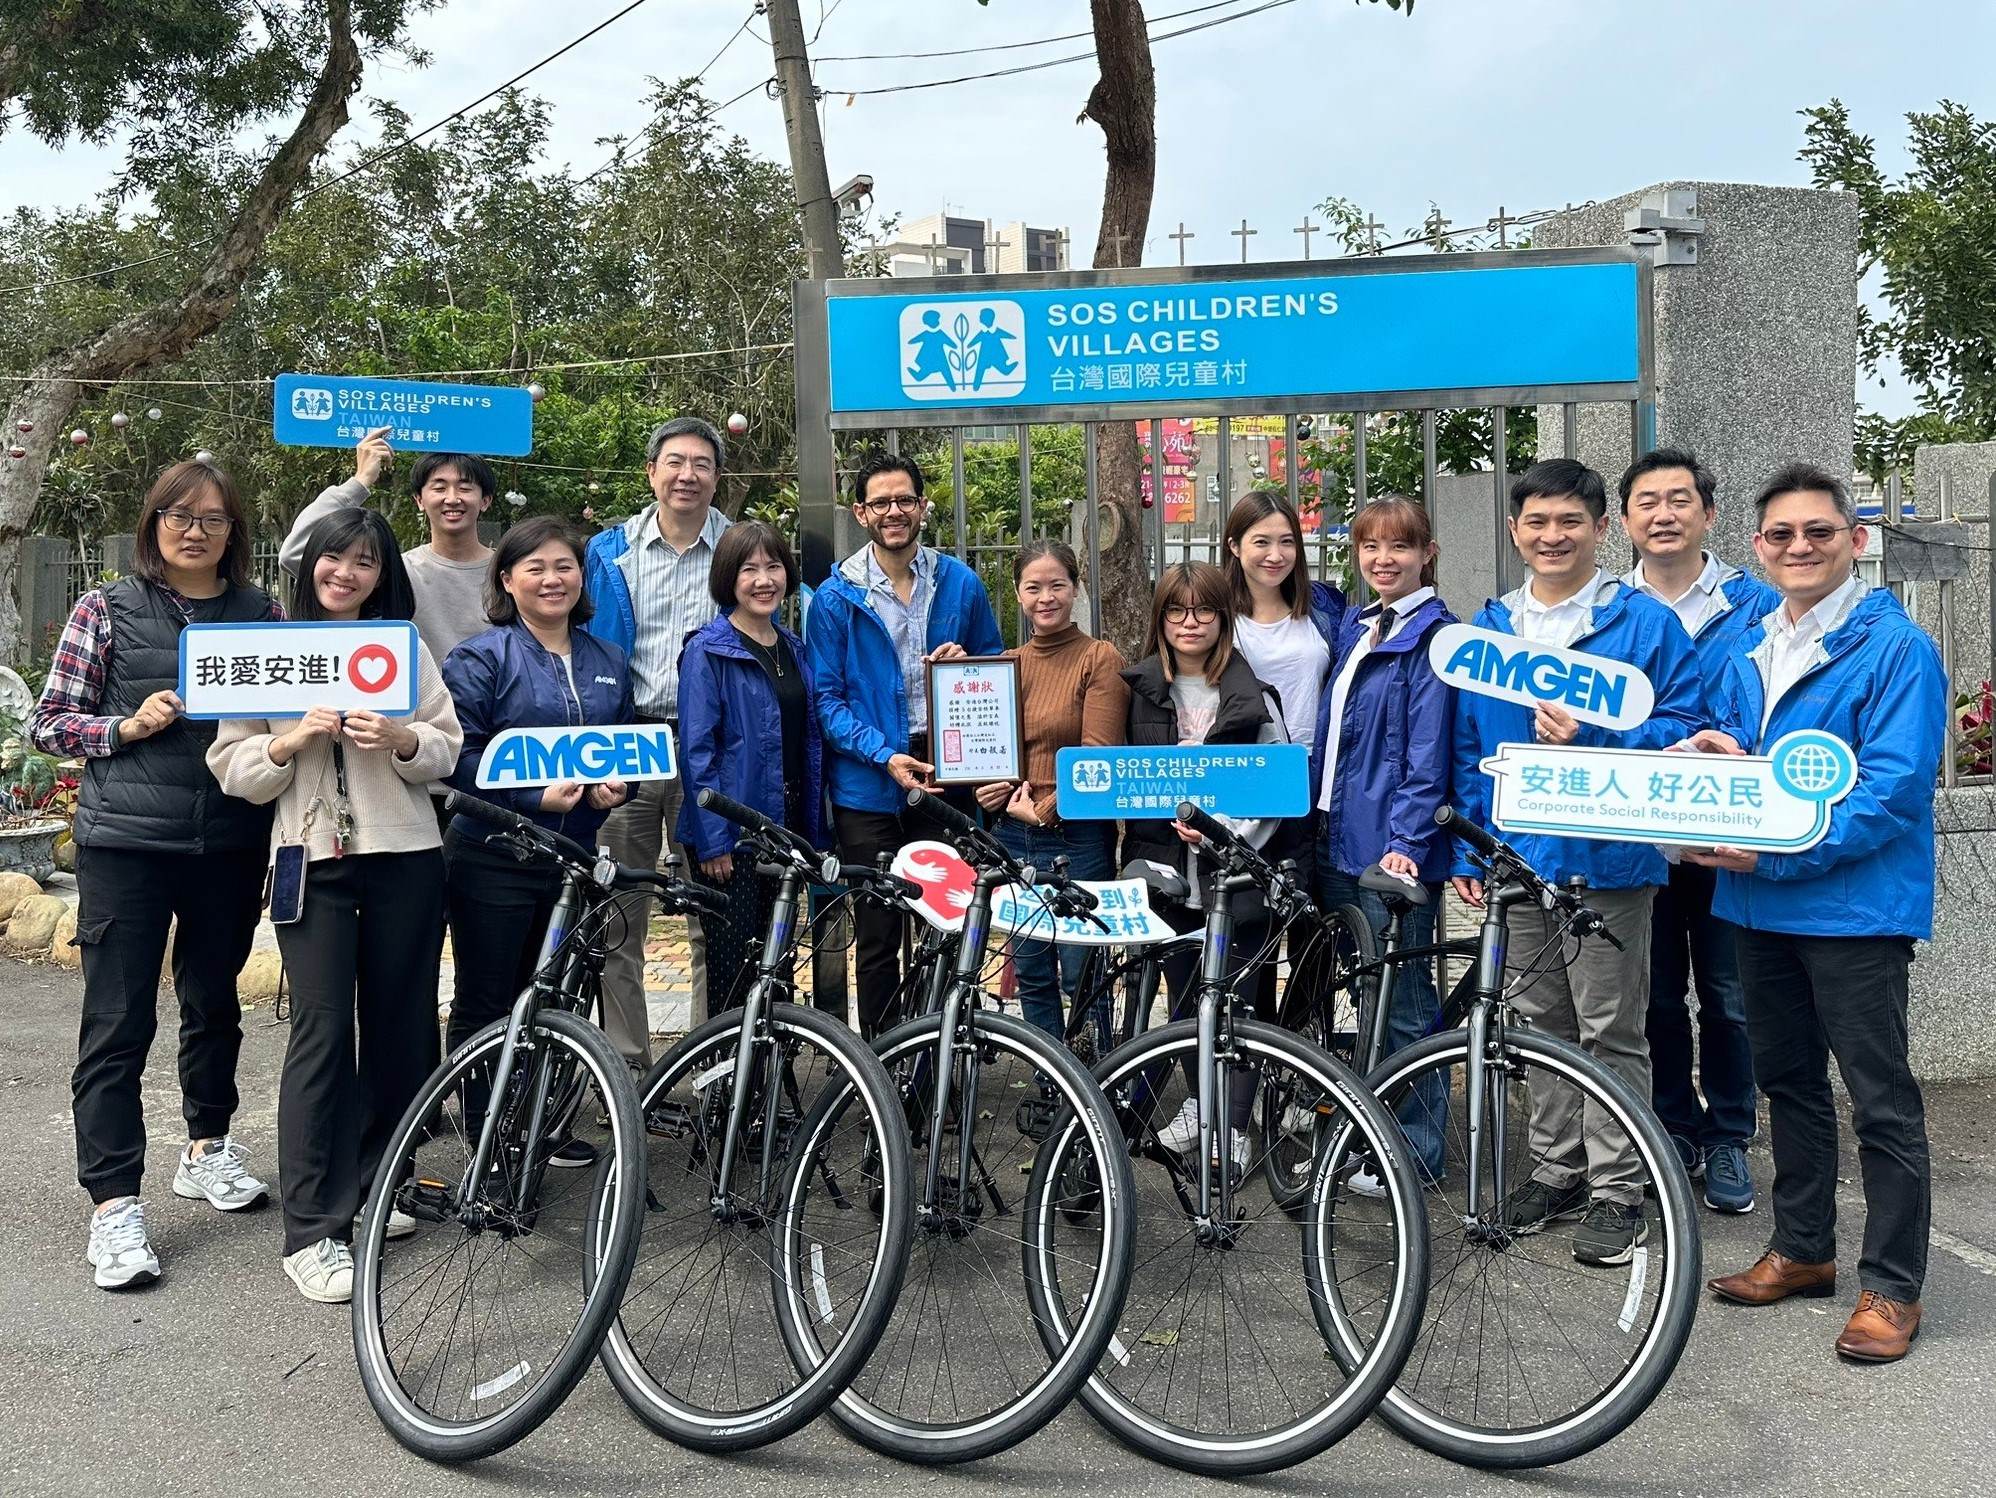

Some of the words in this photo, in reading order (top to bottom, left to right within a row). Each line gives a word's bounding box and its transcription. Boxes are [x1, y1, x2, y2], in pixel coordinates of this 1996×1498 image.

[1047, 302, 1118, 327] SOS
[1126, 291, 1340, 324] CHILDREN'S
[1047, 329, 1221, 358] VILLAGES
[1049, 359, 1249, 393] 台灣國際兒童村
[338, 389, 376, 401] SOS
[380, 391, 492, 408] CHILDREN'S
[338, 399, 431, 414] VILLAGES
[338, 412, 412, 428] TAIWAN
[1164, 492, 1191, 504] 6262
[196, 654, 341, 687] 我愛安進!
[1444, 639, 1627, 718] AMGEN
[953, 680, 994, 694] 感謝狀
[487, 731, 671, 782] AMGEN
[1116, 758, 1151, 768] SOS
[1156, 756, 1266, 768] CHILDREN'S
[1116, 768, 1206, 779] VILLAGES
[1116, 781, 1188, 795] TAIWAN
[1520, 764, 1629, 800] 安進人
[1647, 771, 1764, 808] 好公民
[1517, 798, 1595, 815] Corporate
[1599, 803, 1645, 818] Social
[1650, 807, 1763, 829] Responsibility
[1336, 1080, 1368, 1110] GIANT
[1086, 1107, 1105, 1142] GIANT
[1312, 1171, 1326, 1204] GIANT
